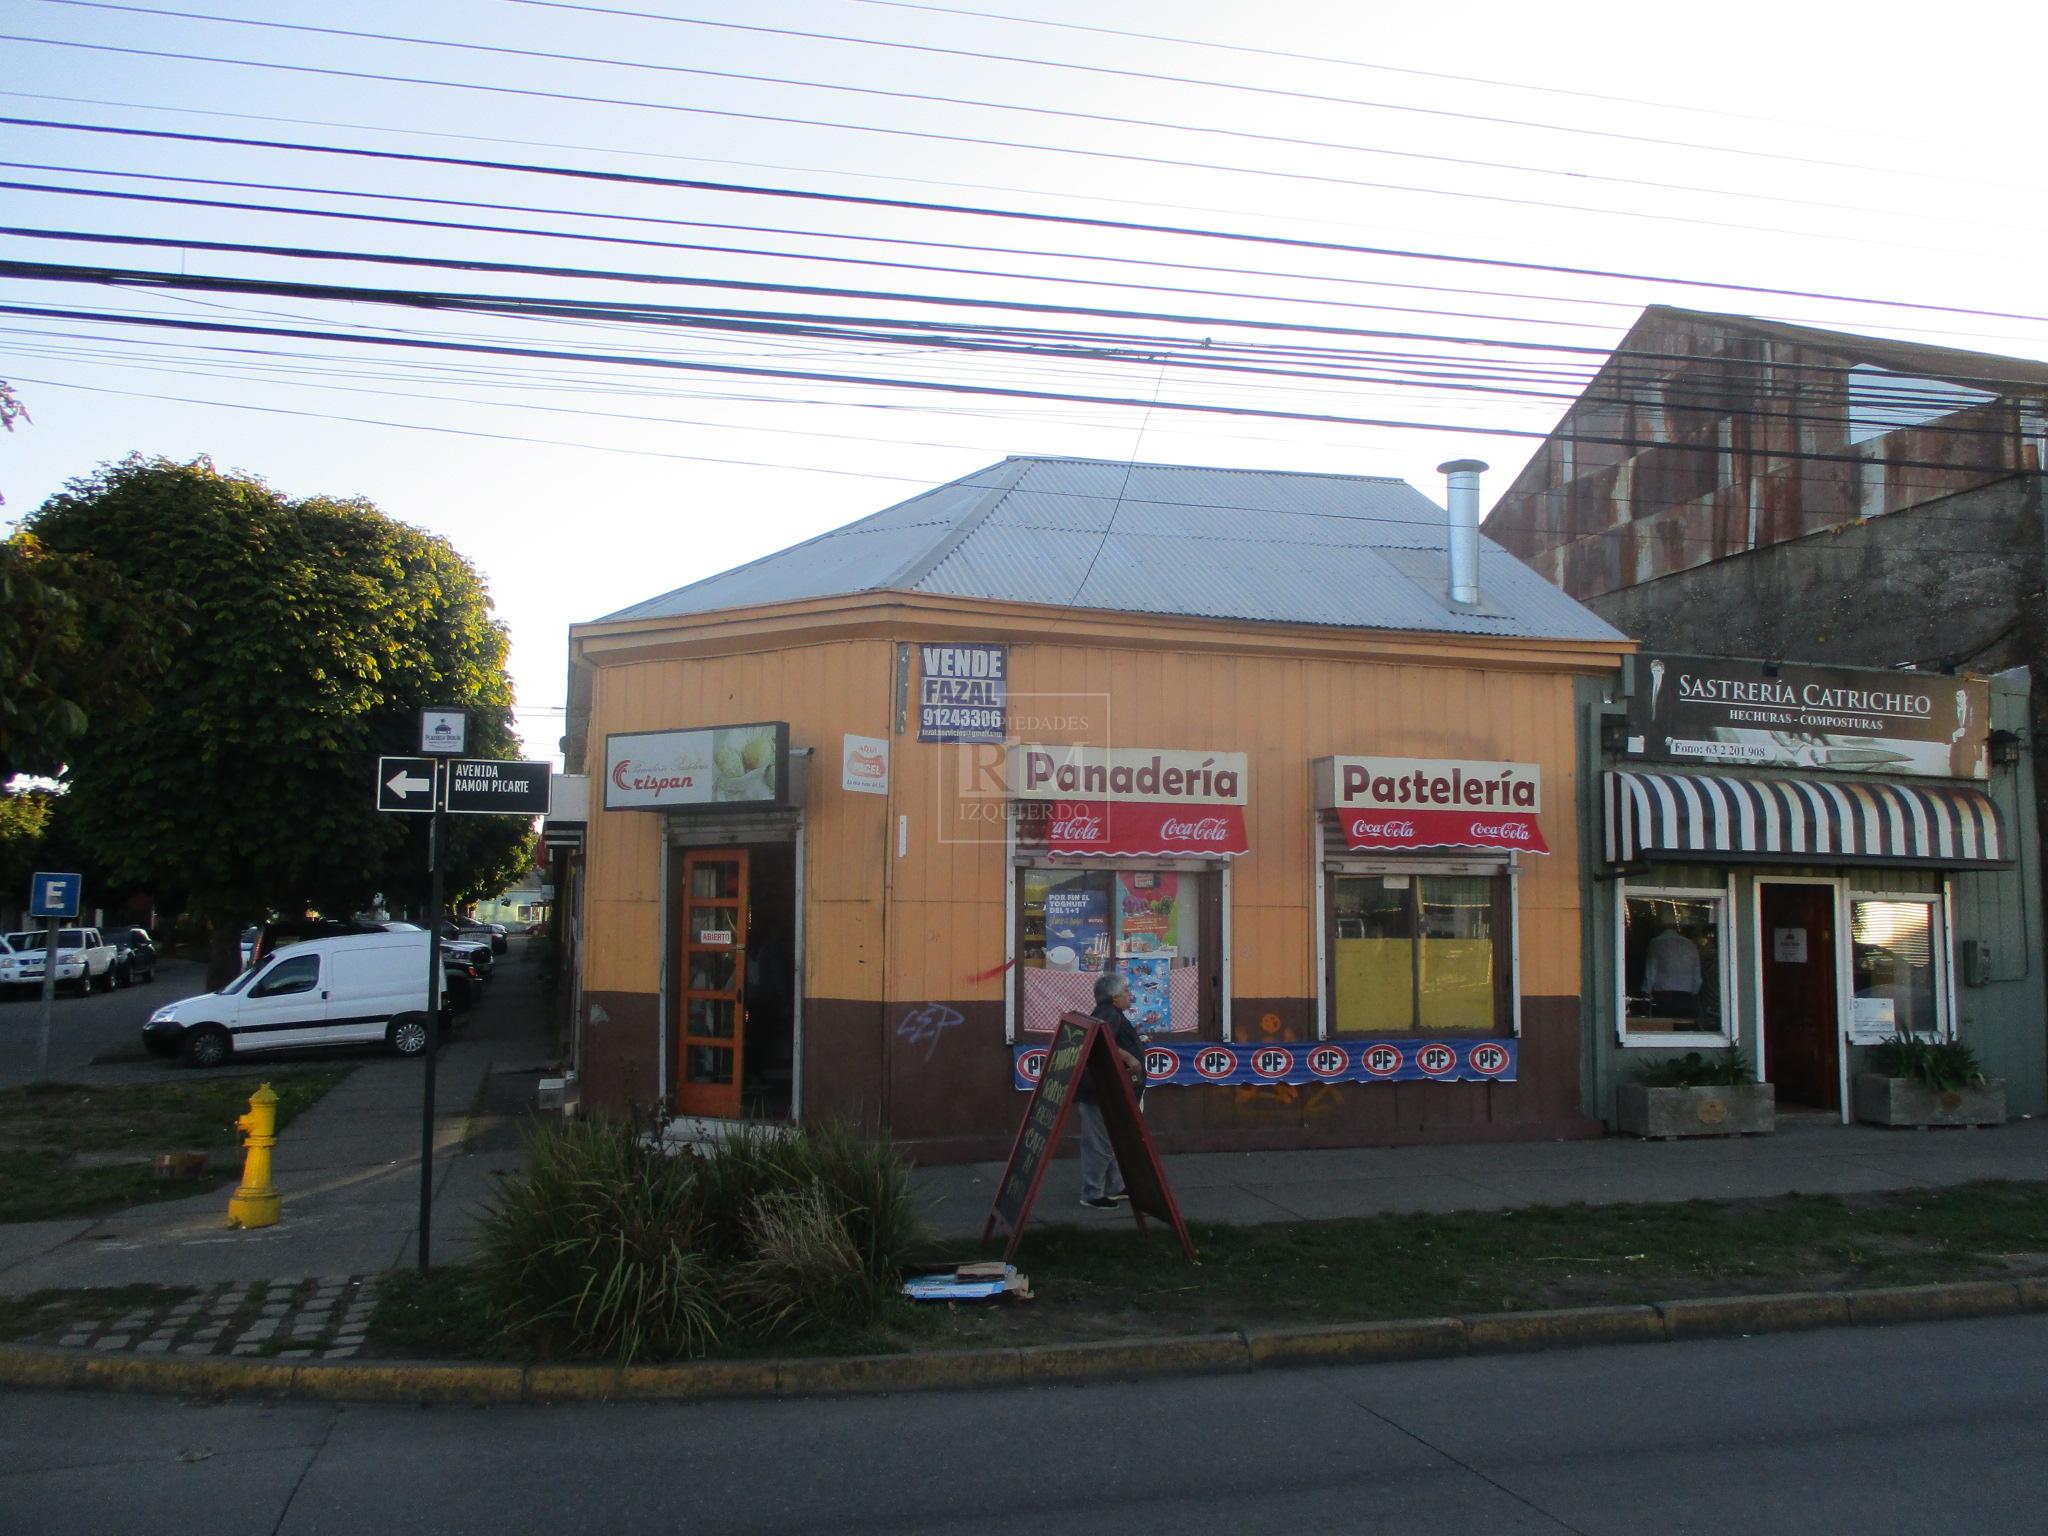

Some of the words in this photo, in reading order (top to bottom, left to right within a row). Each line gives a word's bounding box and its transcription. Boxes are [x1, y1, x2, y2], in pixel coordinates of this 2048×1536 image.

[923, 647, 1002, 678] VENDE
[925, 679, 999, 706] FAZAL
[1679, 674, 1797, 704] SASTRERÍA
[1803, 684, 1932, 715] CATRICHEO
[923, 708, 1001, 728] 91243306
[1729, 709, 1792, 724] HECHURAS
[1799, 715, 1884, 730] COMPOSTURAS
[1674, 742, 1703, 754] Fono:
[1706, 744, 1718, 754] 63
[1720, 745, 1726, 755] 2
[1729, 745, 1745, 756] 201
[1748, 747, 1765, 757] 908
[456, 764, 499, 778] AVENIDA
[612, 759, 693, 798] Crispan
[1026, 751, 1238, 798] Panadería
[455, 779, 489, 792] RAMON
[492, 780, 530, 793] PICARTE
[1342, 764, 1536, 807] Pastelería
[1160, 817, 1229, 841] Coca-Cola
[1352, 819, 1416, 838] Coca-Cola
[1470, 822, 1531, 840] Coca-Cola
[45, 880, 67, 909] E
[703, 933, 730, 941] ABIERTO
[1148, 1053, 1169, 1073] PF
[1204, 1053, 1227, 1073] PF
[1261, 1052, 1283, 1071] PF
[1317, 1051, 1339, 1070] PF
[1372, 1050, 1392, 1069] PF
[1426, 1048, 1447, 1068] PF
[1479, 1048, 1499, 1068] PF
